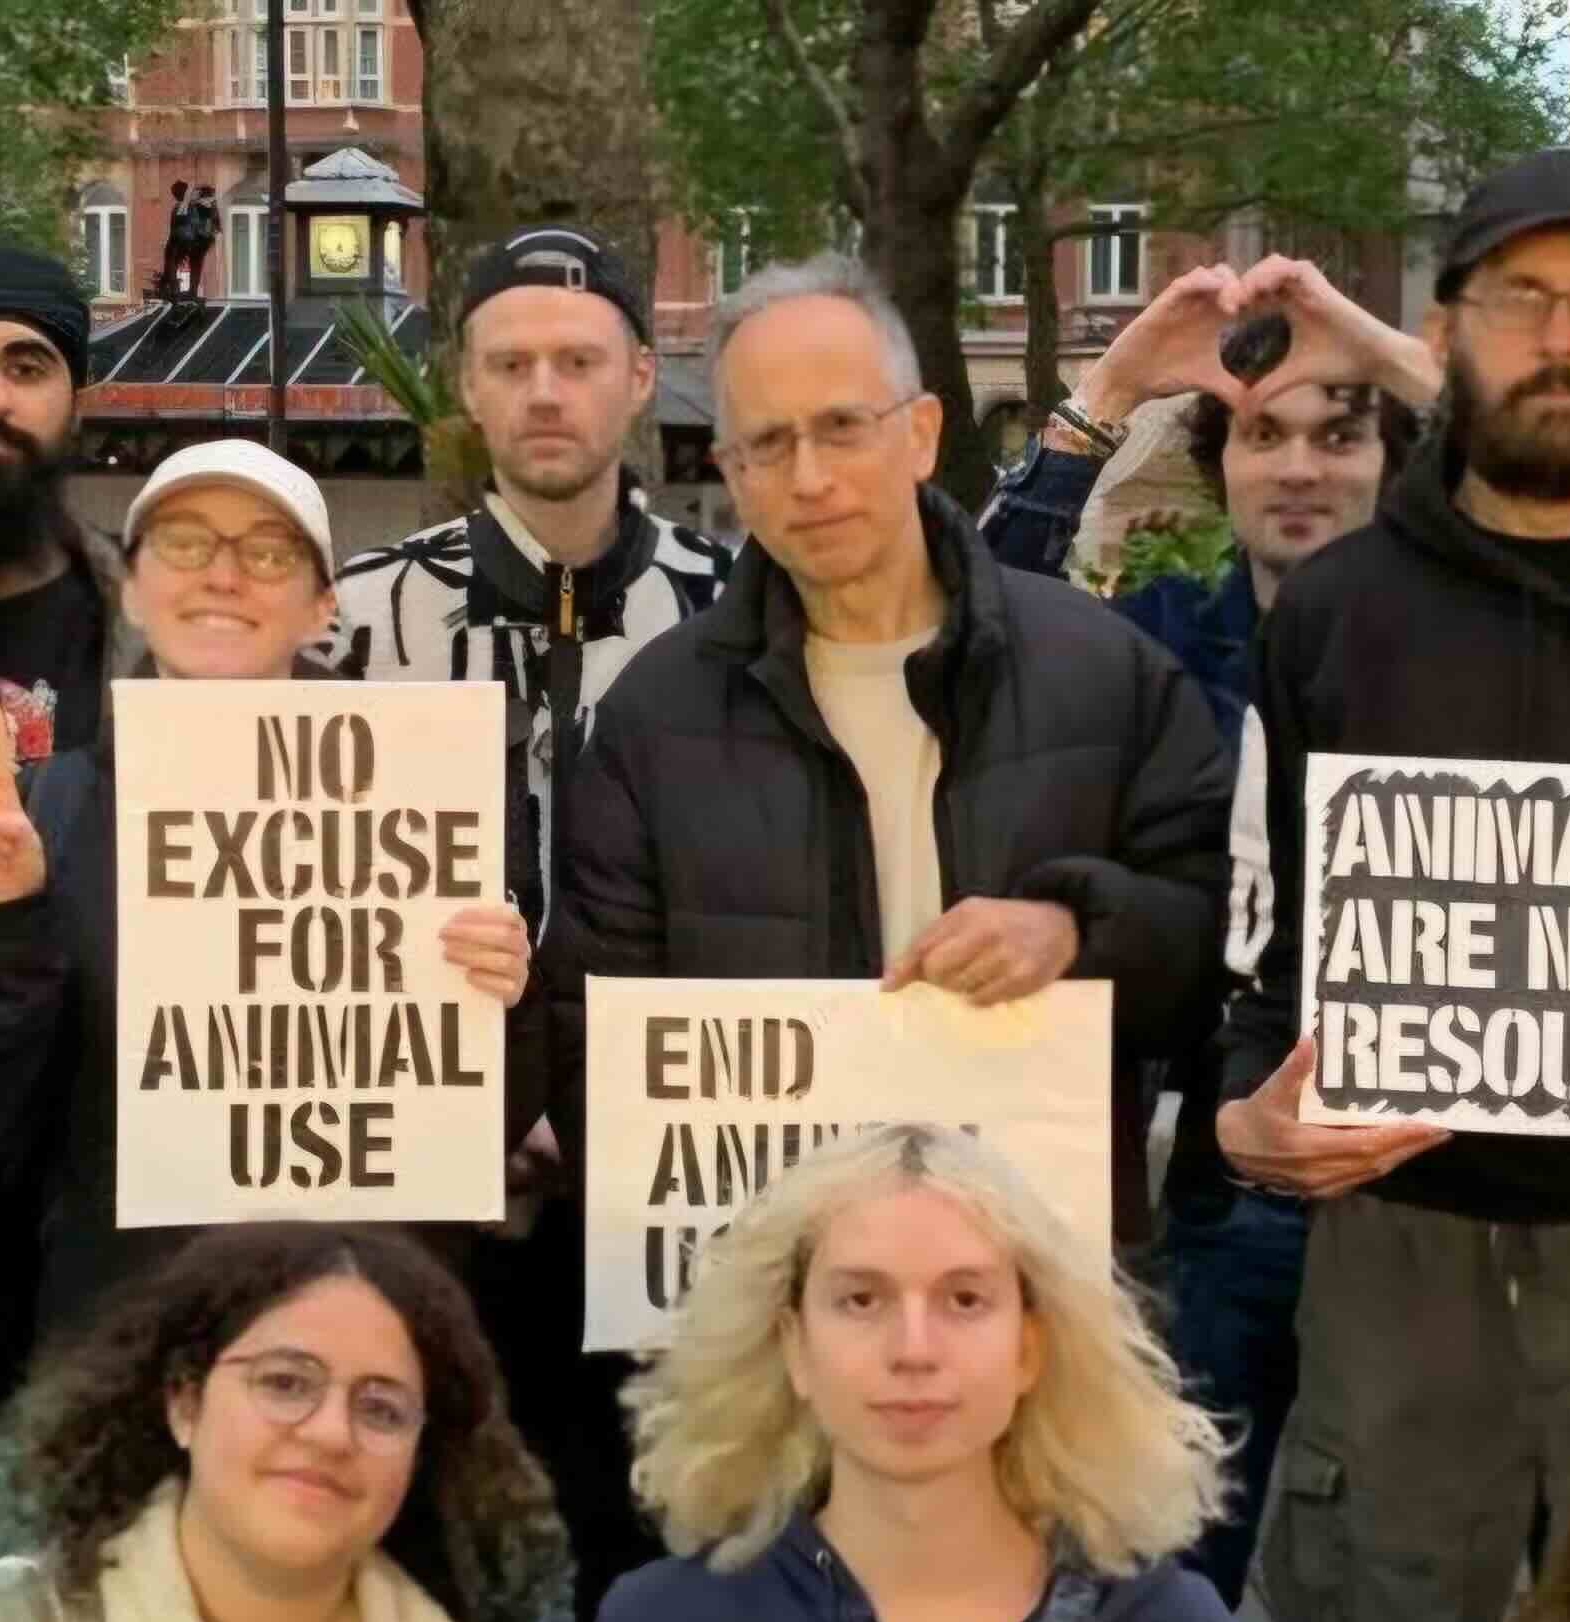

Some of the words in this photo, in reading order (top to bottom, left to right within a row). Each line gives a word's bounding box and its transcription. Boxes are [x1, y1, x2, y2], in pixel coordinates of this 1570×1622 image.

[257, 714, 375, 801] NO
[145, 808, 481, 898] EXCUSE
[237, 906, 405, 994] FOR
[1325, 898, 1496, 990] ARE
[139, 1002, 484, 1090] ANIMAL
[644, 1016, 815, 1100] END
[230, 1101, 395, 1189] USE
